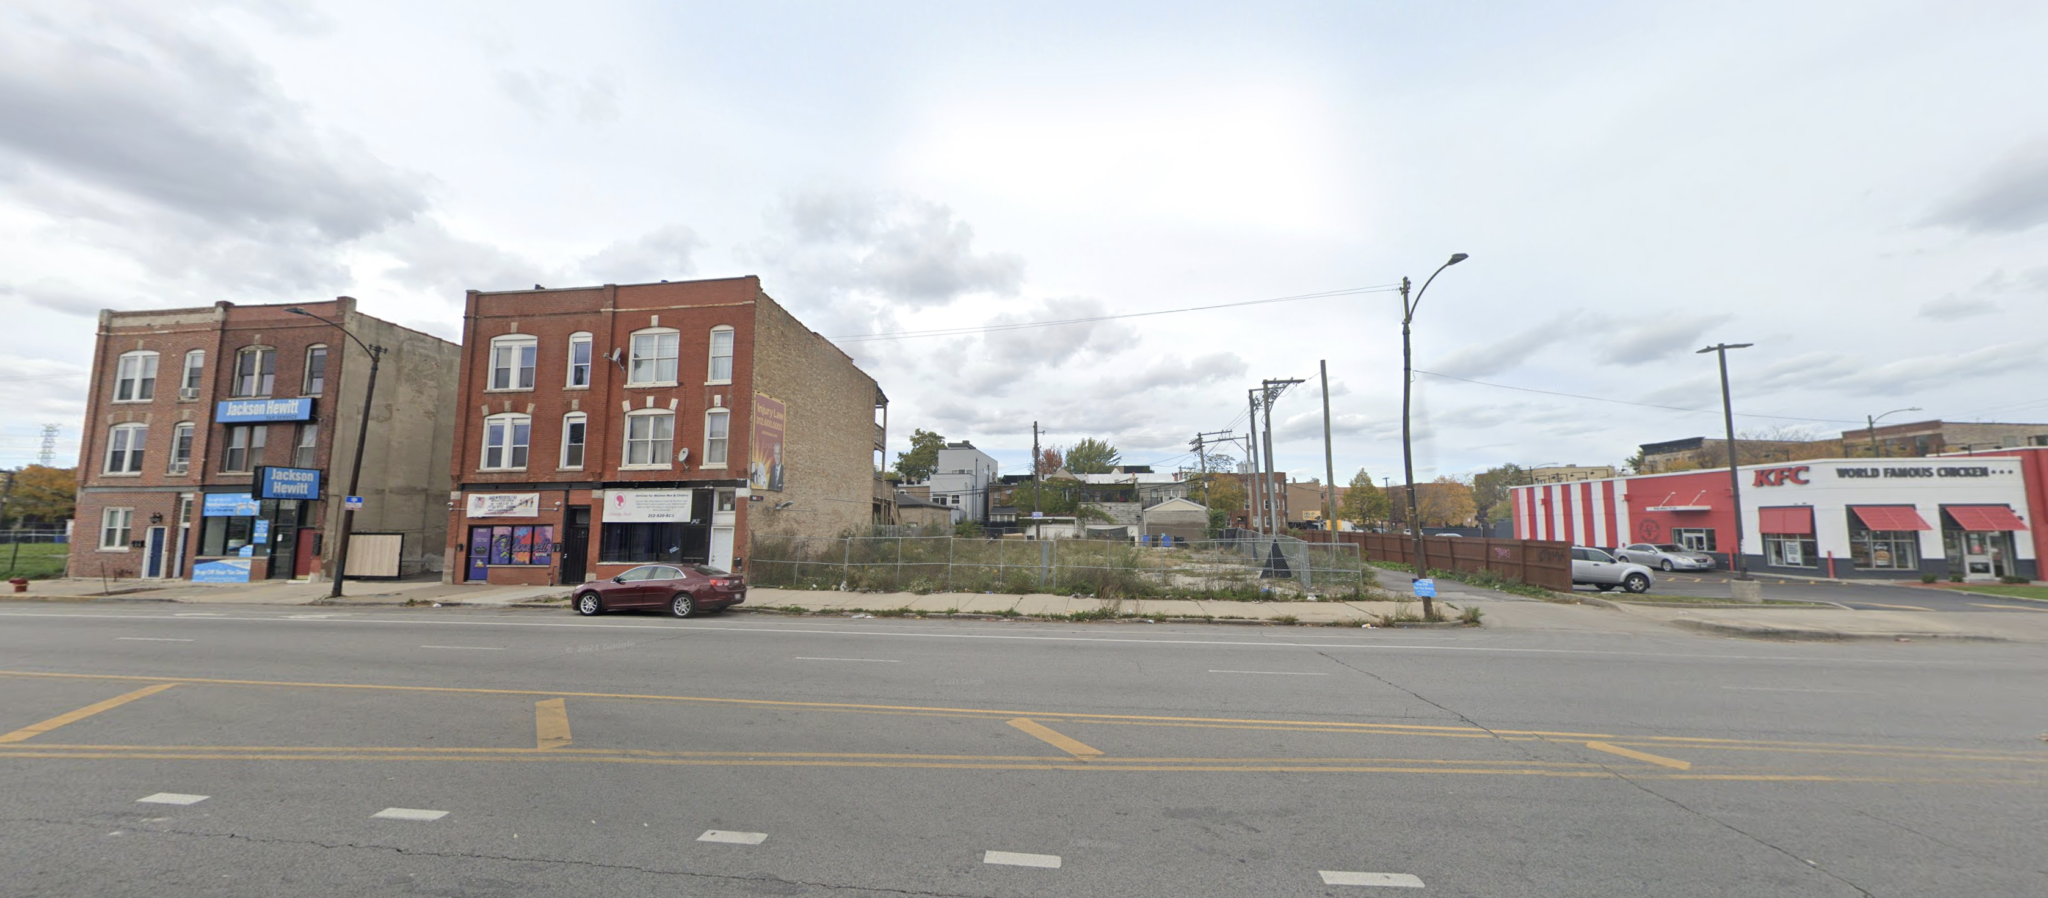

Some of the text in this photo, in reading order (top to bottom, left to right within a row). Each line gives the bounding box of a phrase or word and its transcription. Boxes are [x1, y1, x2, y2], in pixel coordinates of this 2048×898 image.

[226, 400, 299, 416] Jackson Hewitt
[757, 403, 784, 420] Injury Law
[271, 468, 314, 481] Jackson
[1752, 466, 1809, 487] KFC
[1836, 467, 1989, 478] WORLD FAMOUS CHICKEN
[273, 481, 308, 494] Hewitt
